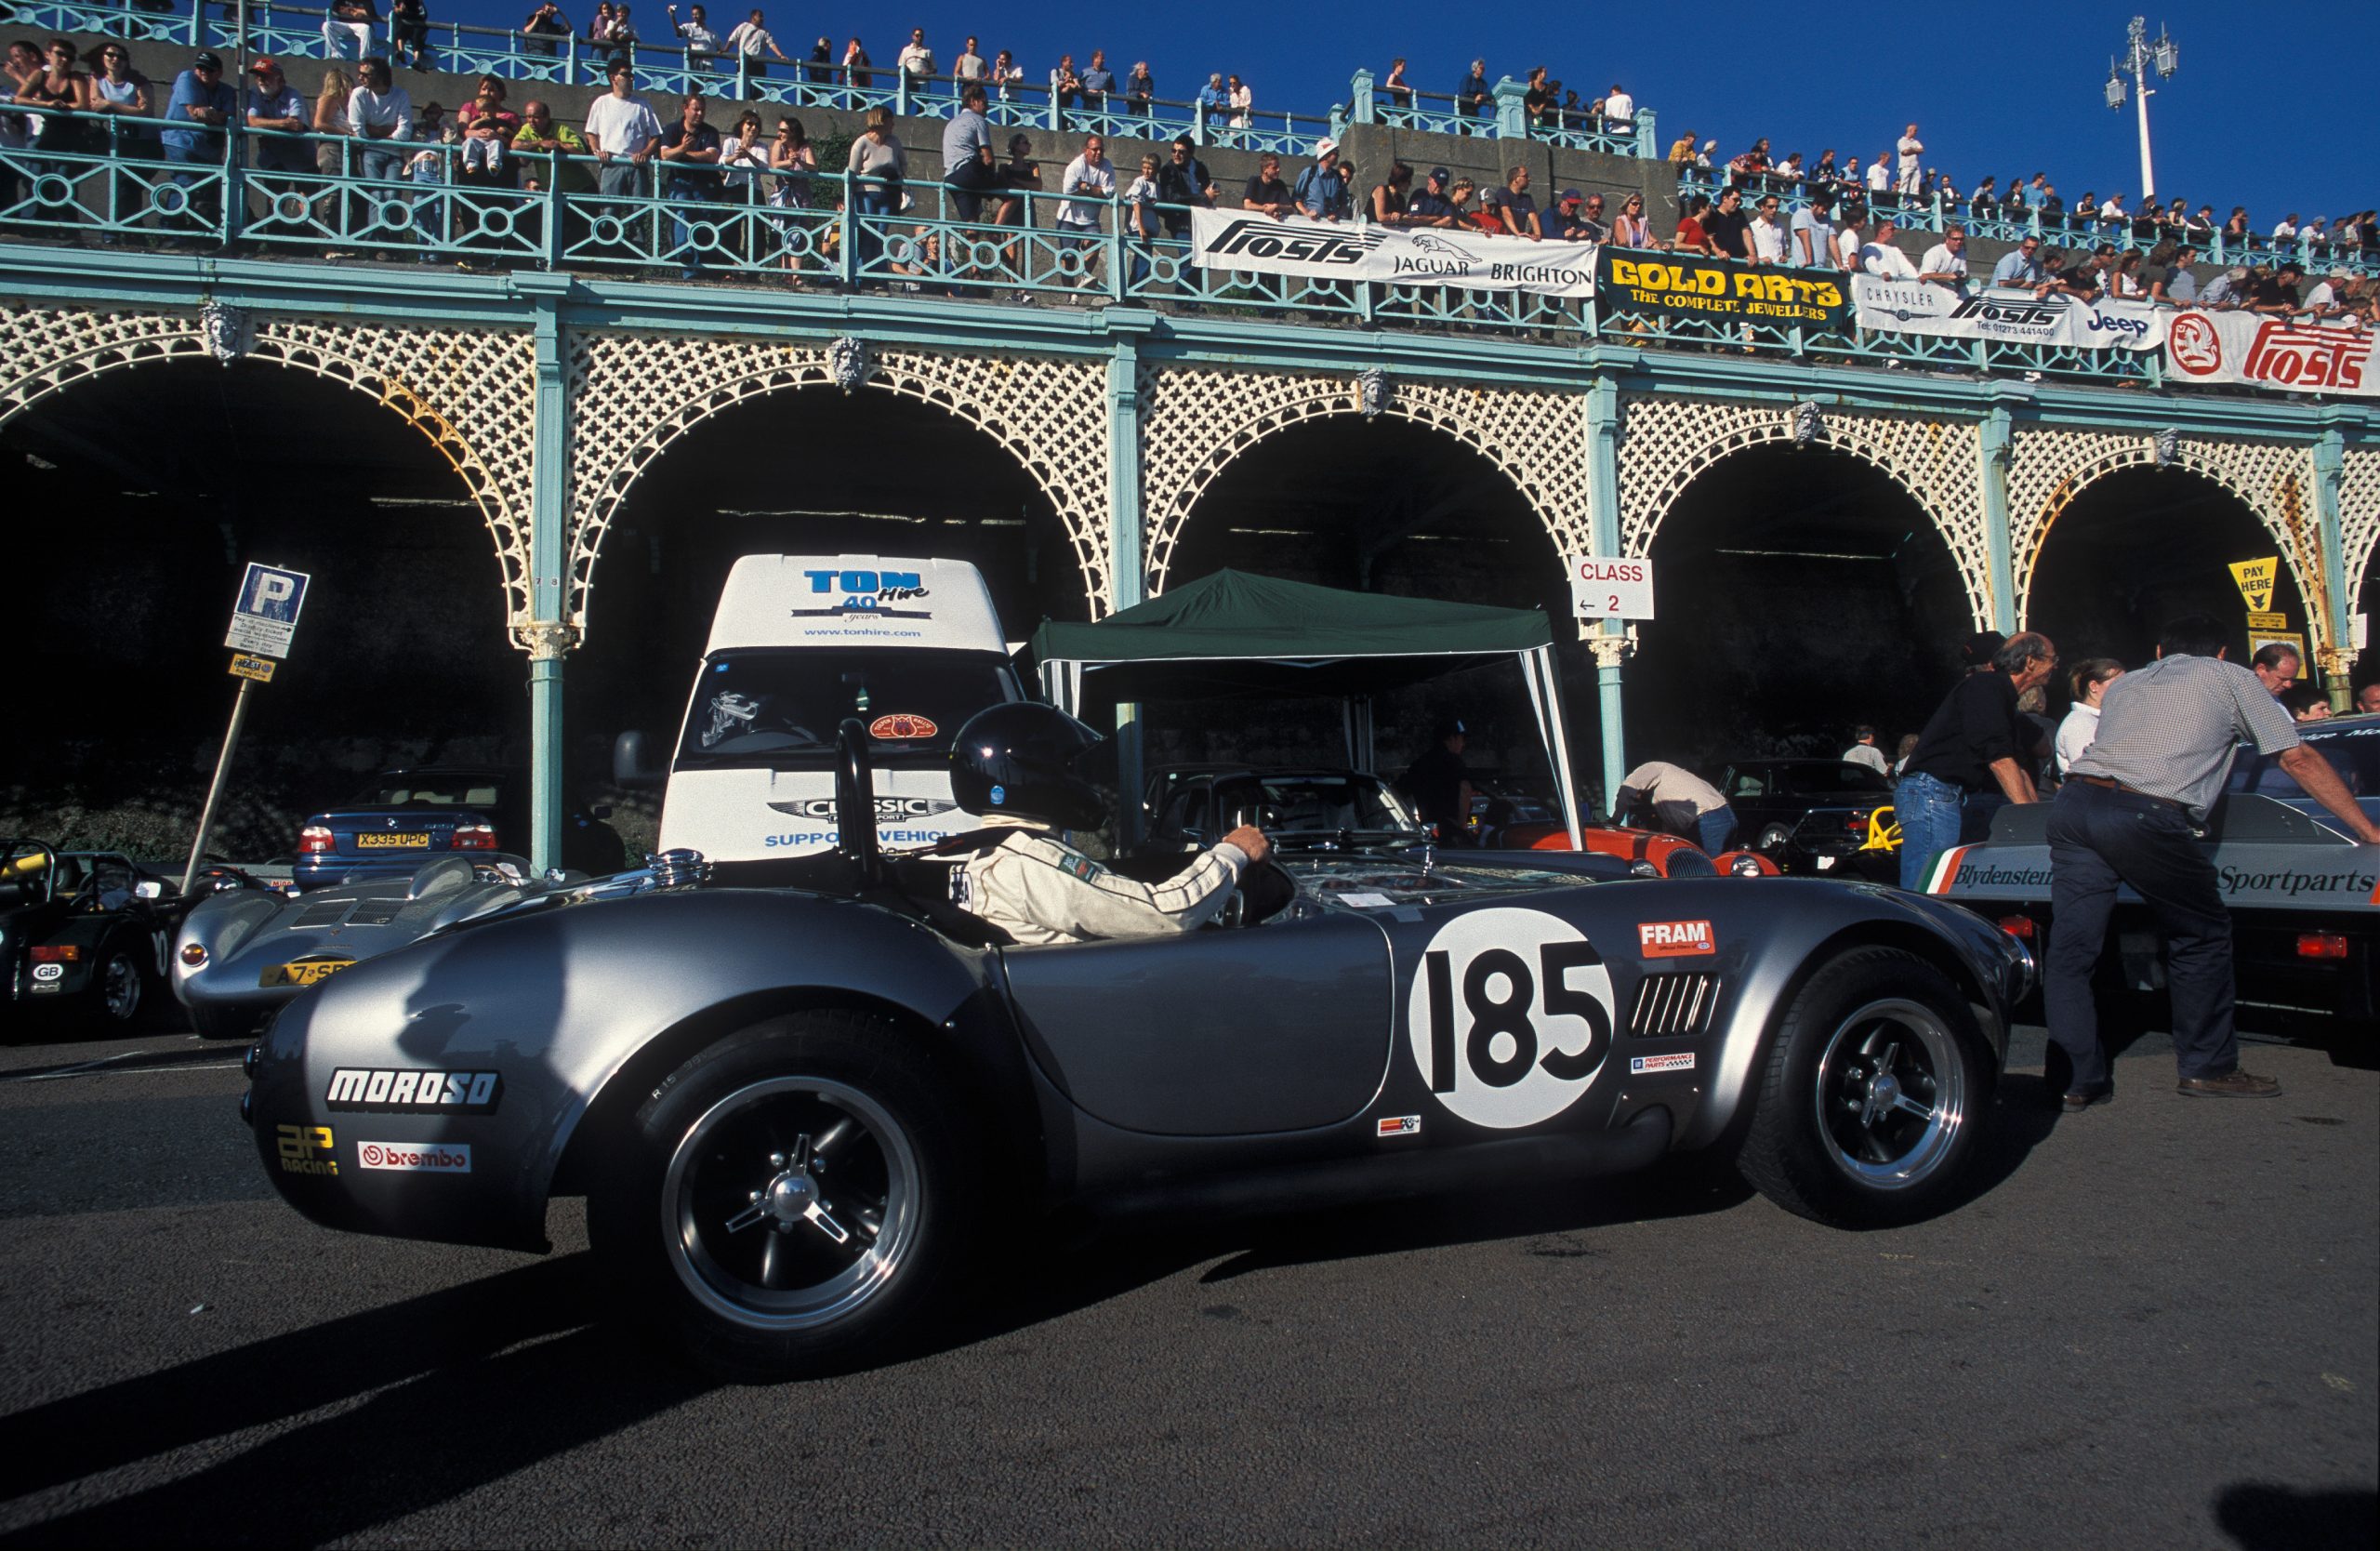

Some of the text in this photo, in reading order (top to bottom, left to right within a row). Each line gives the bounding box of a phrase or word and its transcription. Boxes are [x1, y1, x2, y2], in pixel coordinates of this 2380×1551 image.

[1394, 255, 1592, 285] JAGUAR BRIGHTON
[1611, 258, 1842, 307] GOLD ARTS
[1630, 288, 1827, 321] THE COMPLETE JEWELLERS
[1867, 286, 1934, 307] CHRYSLER
[1993, 324, 2017, 334] 01273
[2020, 325, 2055, 336] 441400
[2088, 310, 2149, 338] Jeep
[1580, 563, 1644, 582] CLASS
[2242, 565, 2264, 578] PAY
[804, 570, 921, 593] TON
[2241, 577, 2272, 592] HERE
[251, 572, 295, 614] P
[878, 588, 931, 602] Hire
[842, 596, 877, 609] 40
[1608, 595, 1620, 611] 2
[844, 614, 879, 623] years
[804, 629, 921, 637] www.tonhire.com
[805, 799, 928, 815] CLSSIC
[361, 834, 427, 845] X335 UPC
[765, 830, 960, 847] SUPPO VEHIC
[2217, 866, 2375, 896] Sportparts
[1641, 922, 1706, 945] FRAM
[38, 966, 60, 977] GB
[1425, 940, 1613, 1094] 185
[1645, 1054, 1693, 1063] PERFORMANCE
[327, 1069, 498, 1105] MOROSO
[386, 1147, 466, 1168] brembo
